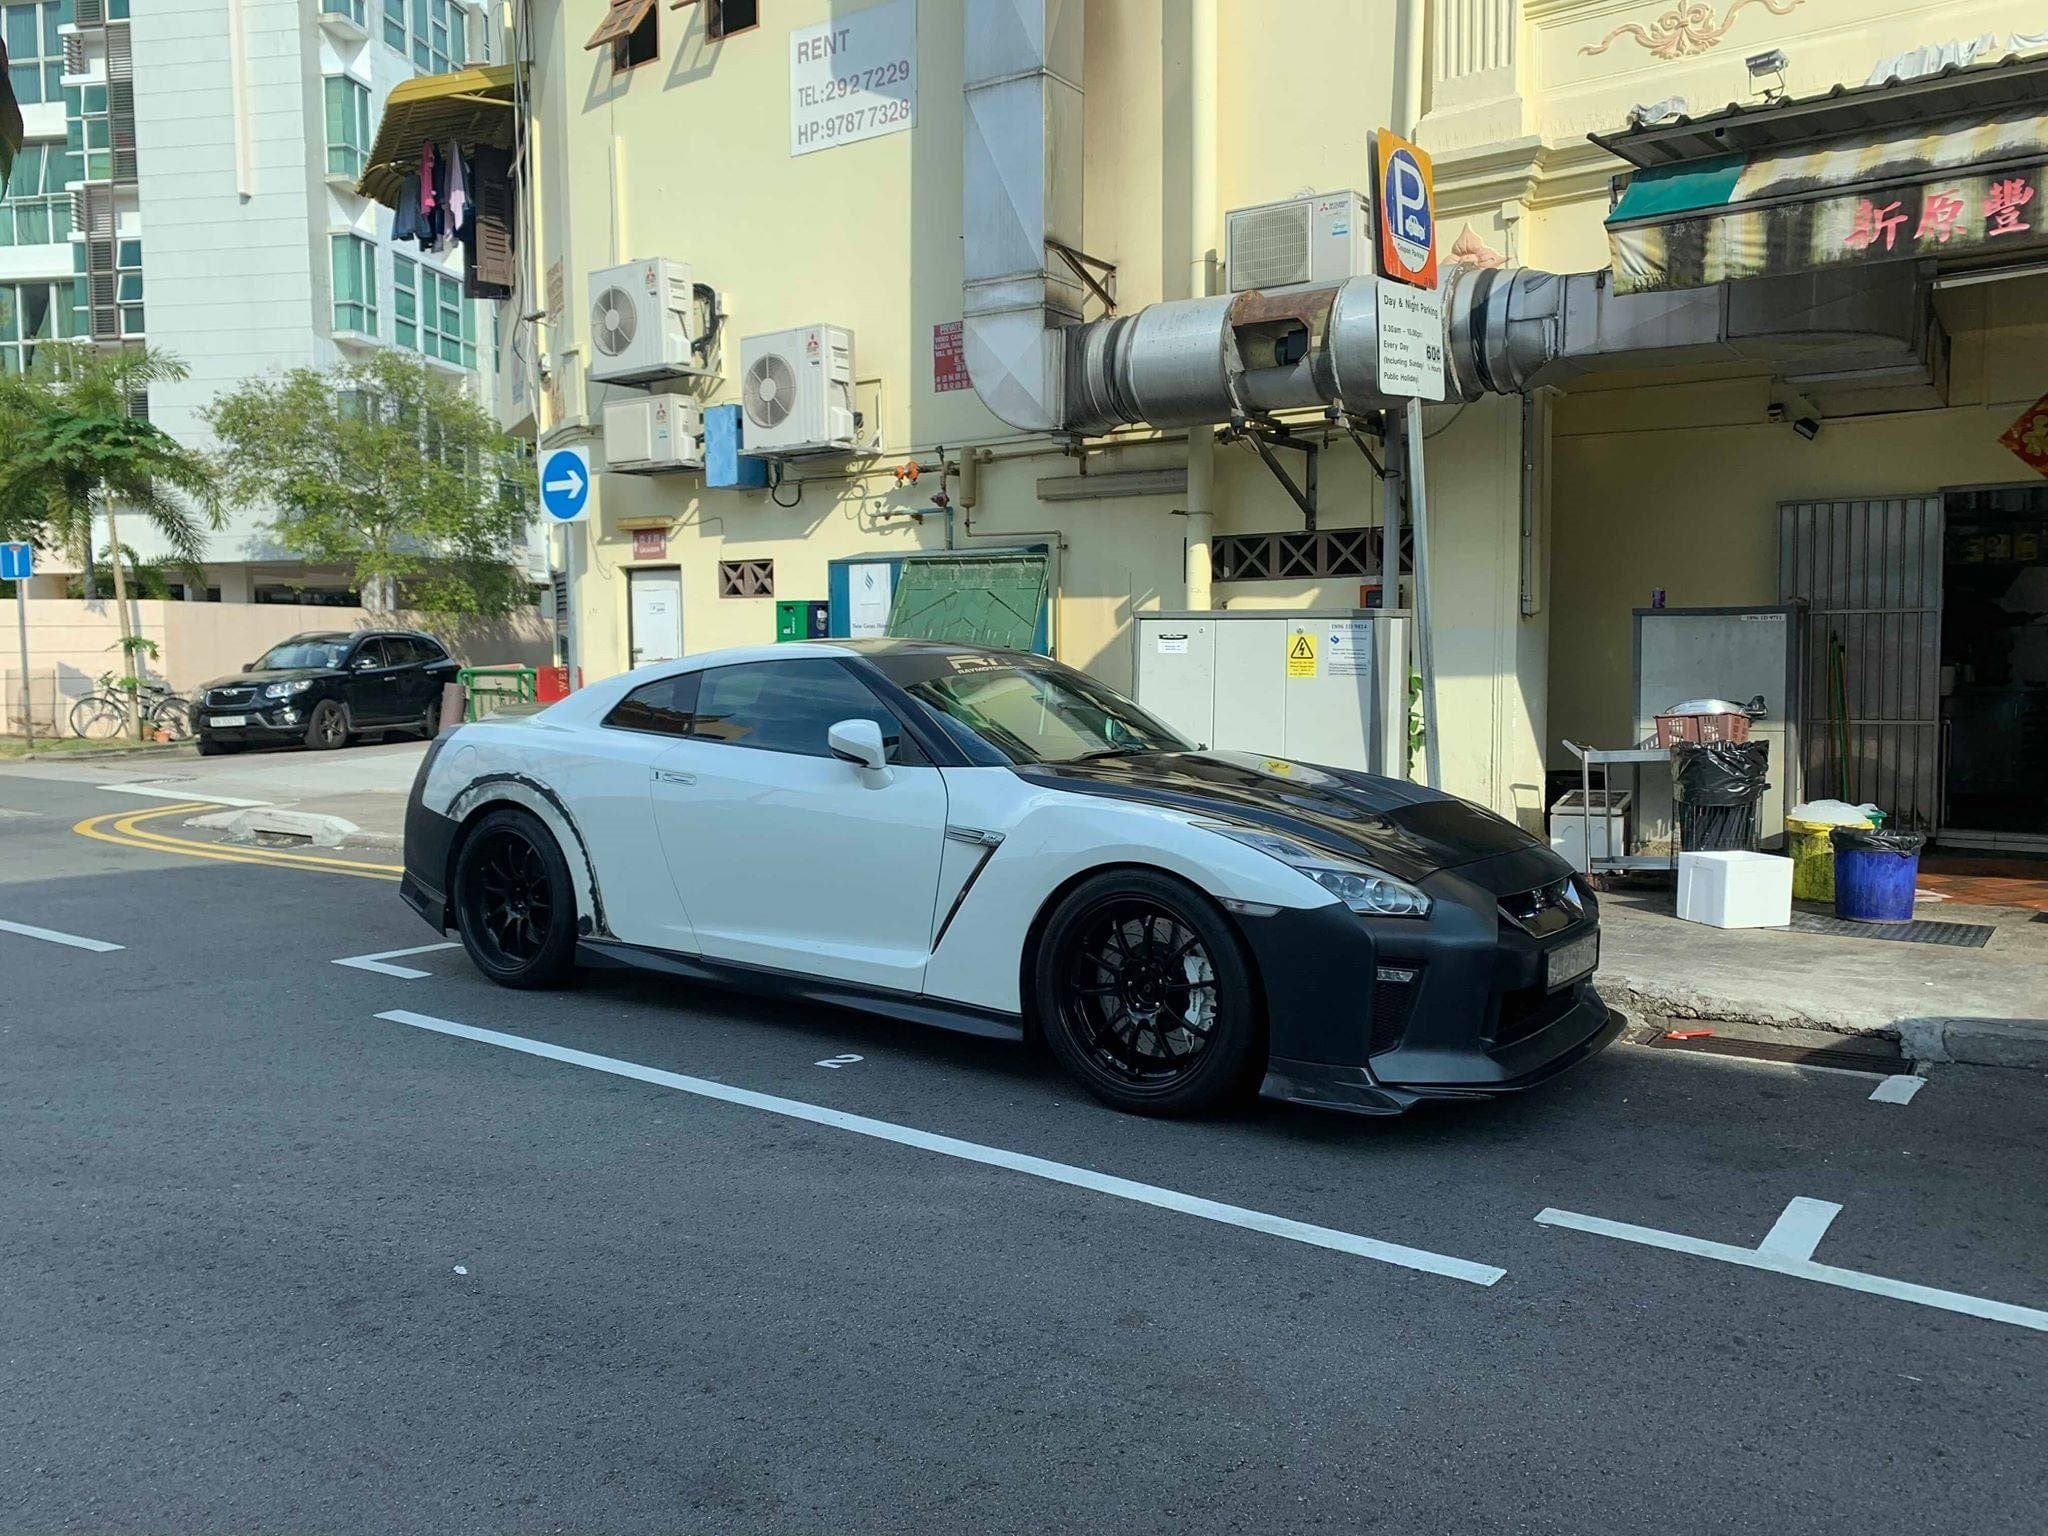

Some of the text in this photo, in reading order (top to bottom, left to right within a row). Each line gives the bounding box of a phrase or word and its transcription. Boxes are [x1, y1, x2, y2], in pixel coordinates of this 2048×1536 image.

[797, 28, 850, 64] RENT
[1394, 156, 1425, 236] P
[1383, 294, 1439, 319] Day & Night Parking
[1383, 340, 1409, 353] Every Day
[1383, 371, 1399, 381] Public
